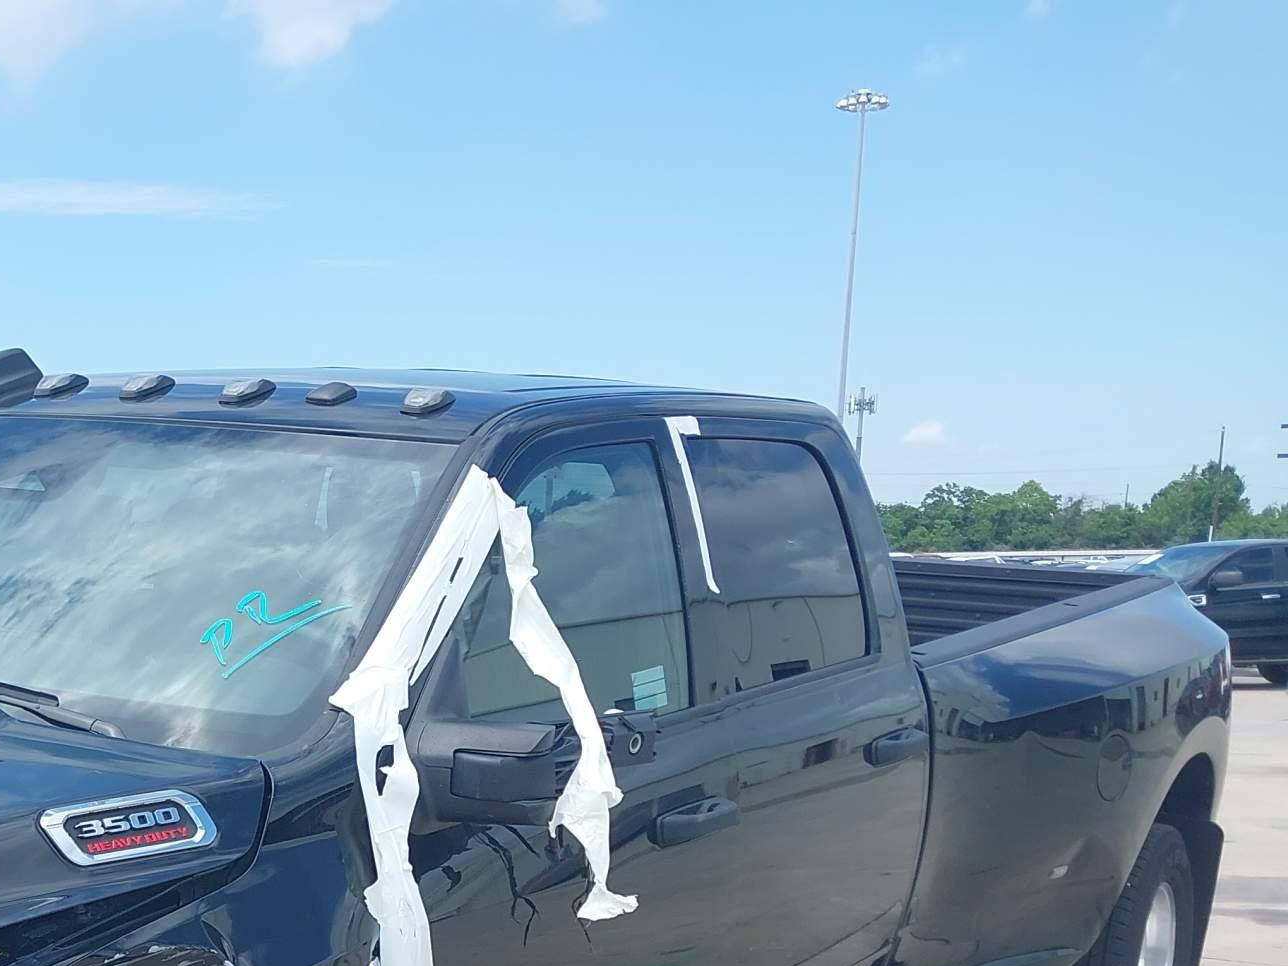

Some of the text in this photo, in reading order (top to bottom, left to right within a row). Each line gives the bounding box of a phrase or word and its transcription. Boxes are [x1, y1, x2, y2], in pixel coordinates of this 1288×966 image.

[74, 807, 181, 837] 3500
[87, 827, 189, 853] HEAVY DUTY
